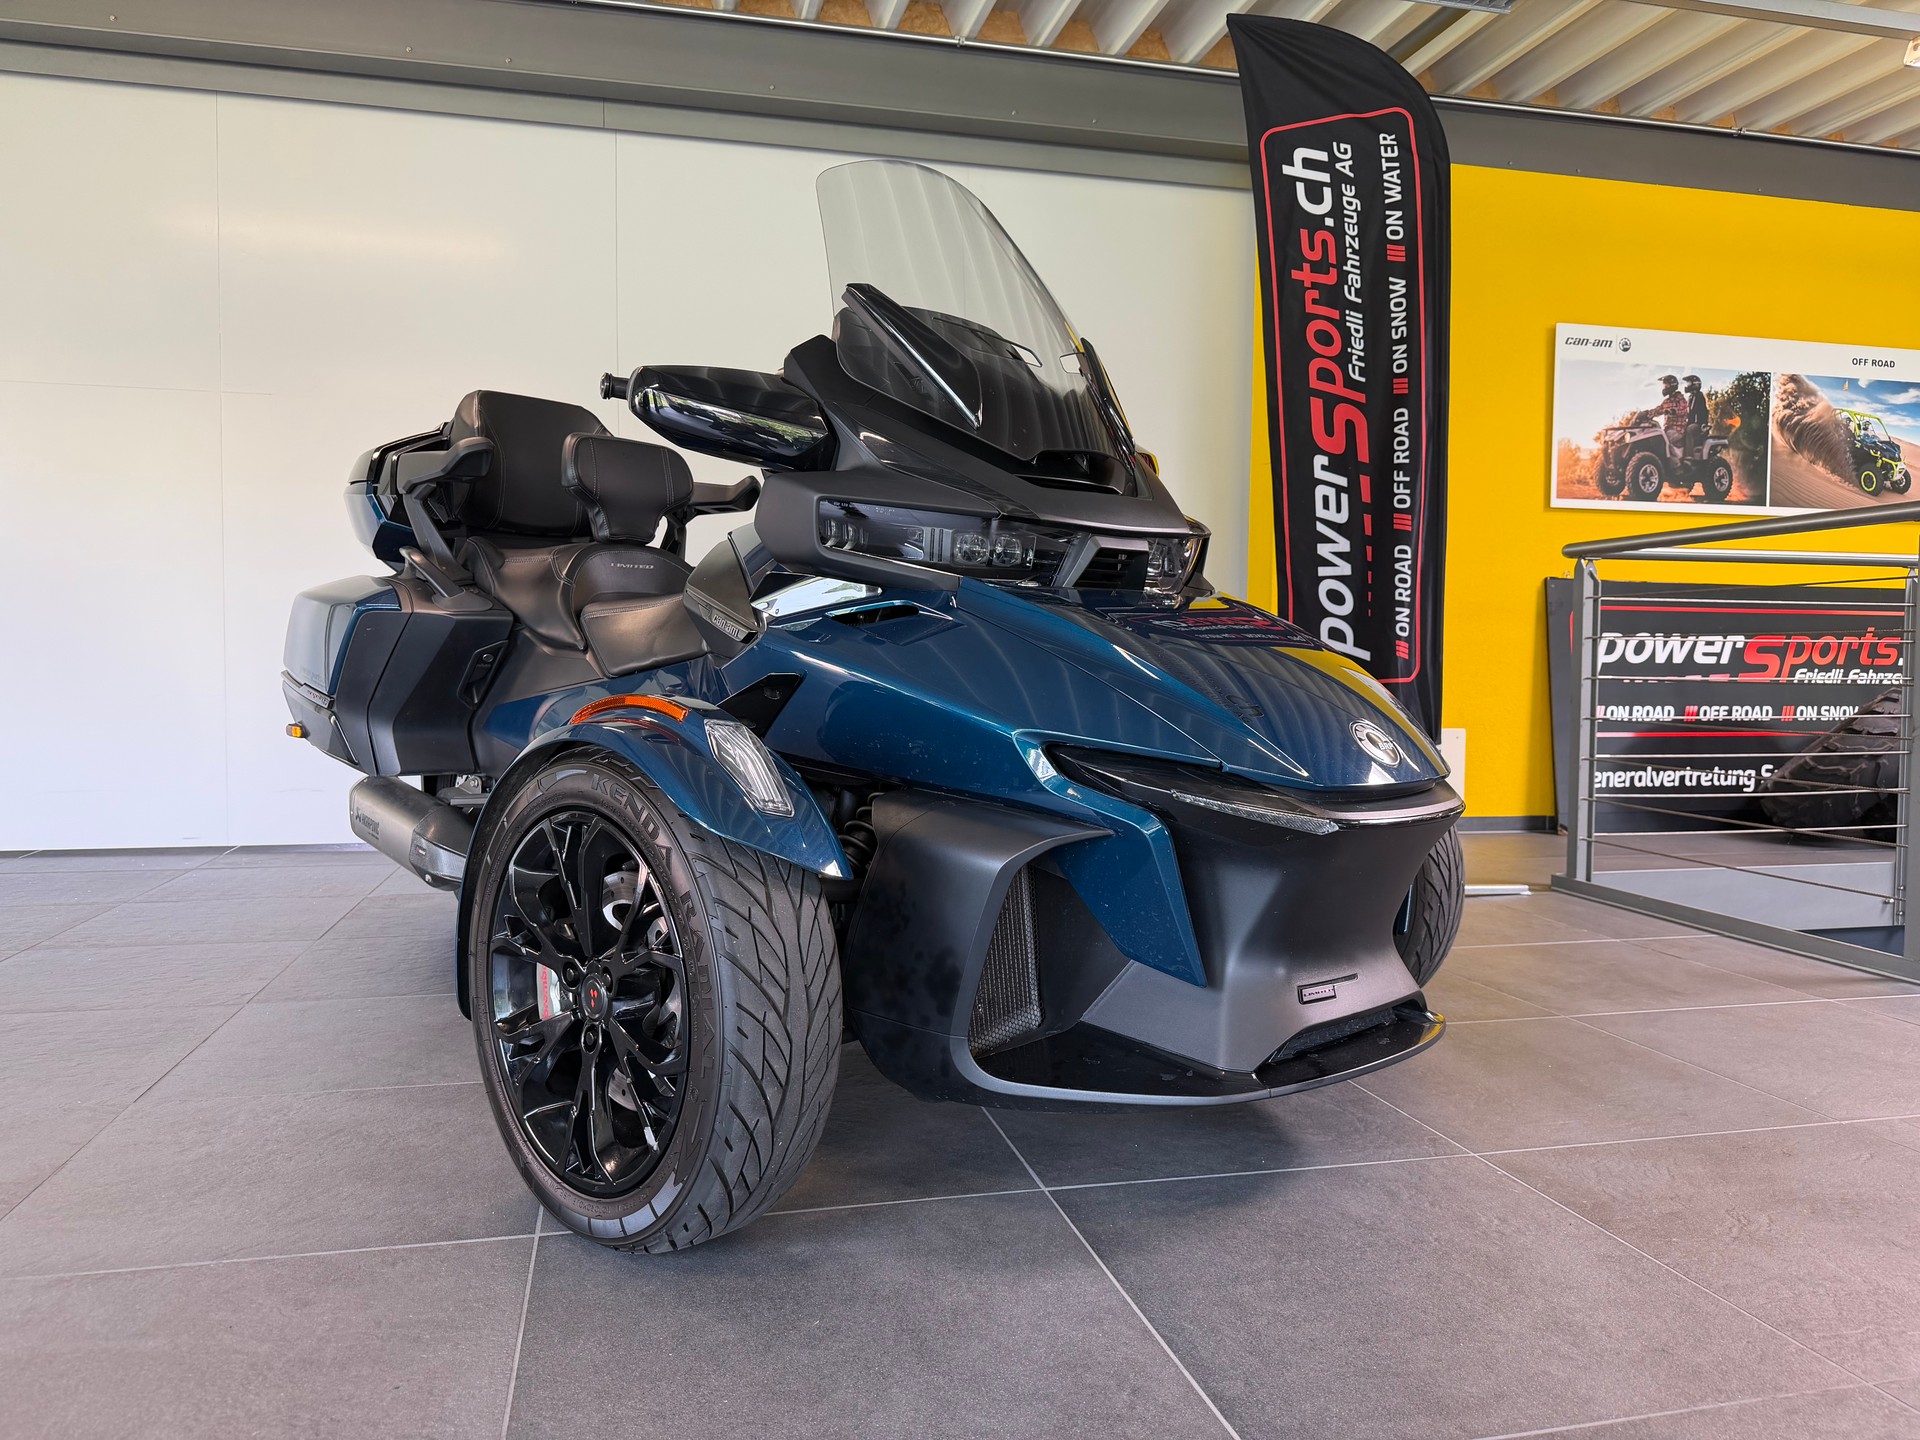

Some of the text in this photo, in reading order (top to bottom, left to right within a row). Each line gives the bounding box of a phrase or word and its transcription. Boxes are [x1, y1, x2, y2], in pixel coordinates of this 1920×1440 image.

[1333, 142, 1366, 382] Friedli Fahrzeuge AG
[1564, 335, 1613, 349] can-am
[1851, 357, 1896, 369] OFF ROAD
[1379, 133, 1411, 637] ON ROAD OFF ROAD ON SNOW ON WATER
[1282, 147, 1371, 661] powerSports.ch
[1793, 668, 1903, 685] Friedli Fahrze
[1606, 705, 1629, 722] ON
[1632, 705, 1675, 722] ROAD
[1699, 705, 1729, 722] OFF
[1732, 705, 1773, 722] ROAD
[1796, 705, 1818, 721] ON
[1594, 766, 1756, 793] eneralvertretung
[590, 773, 673, 876] KENDA
